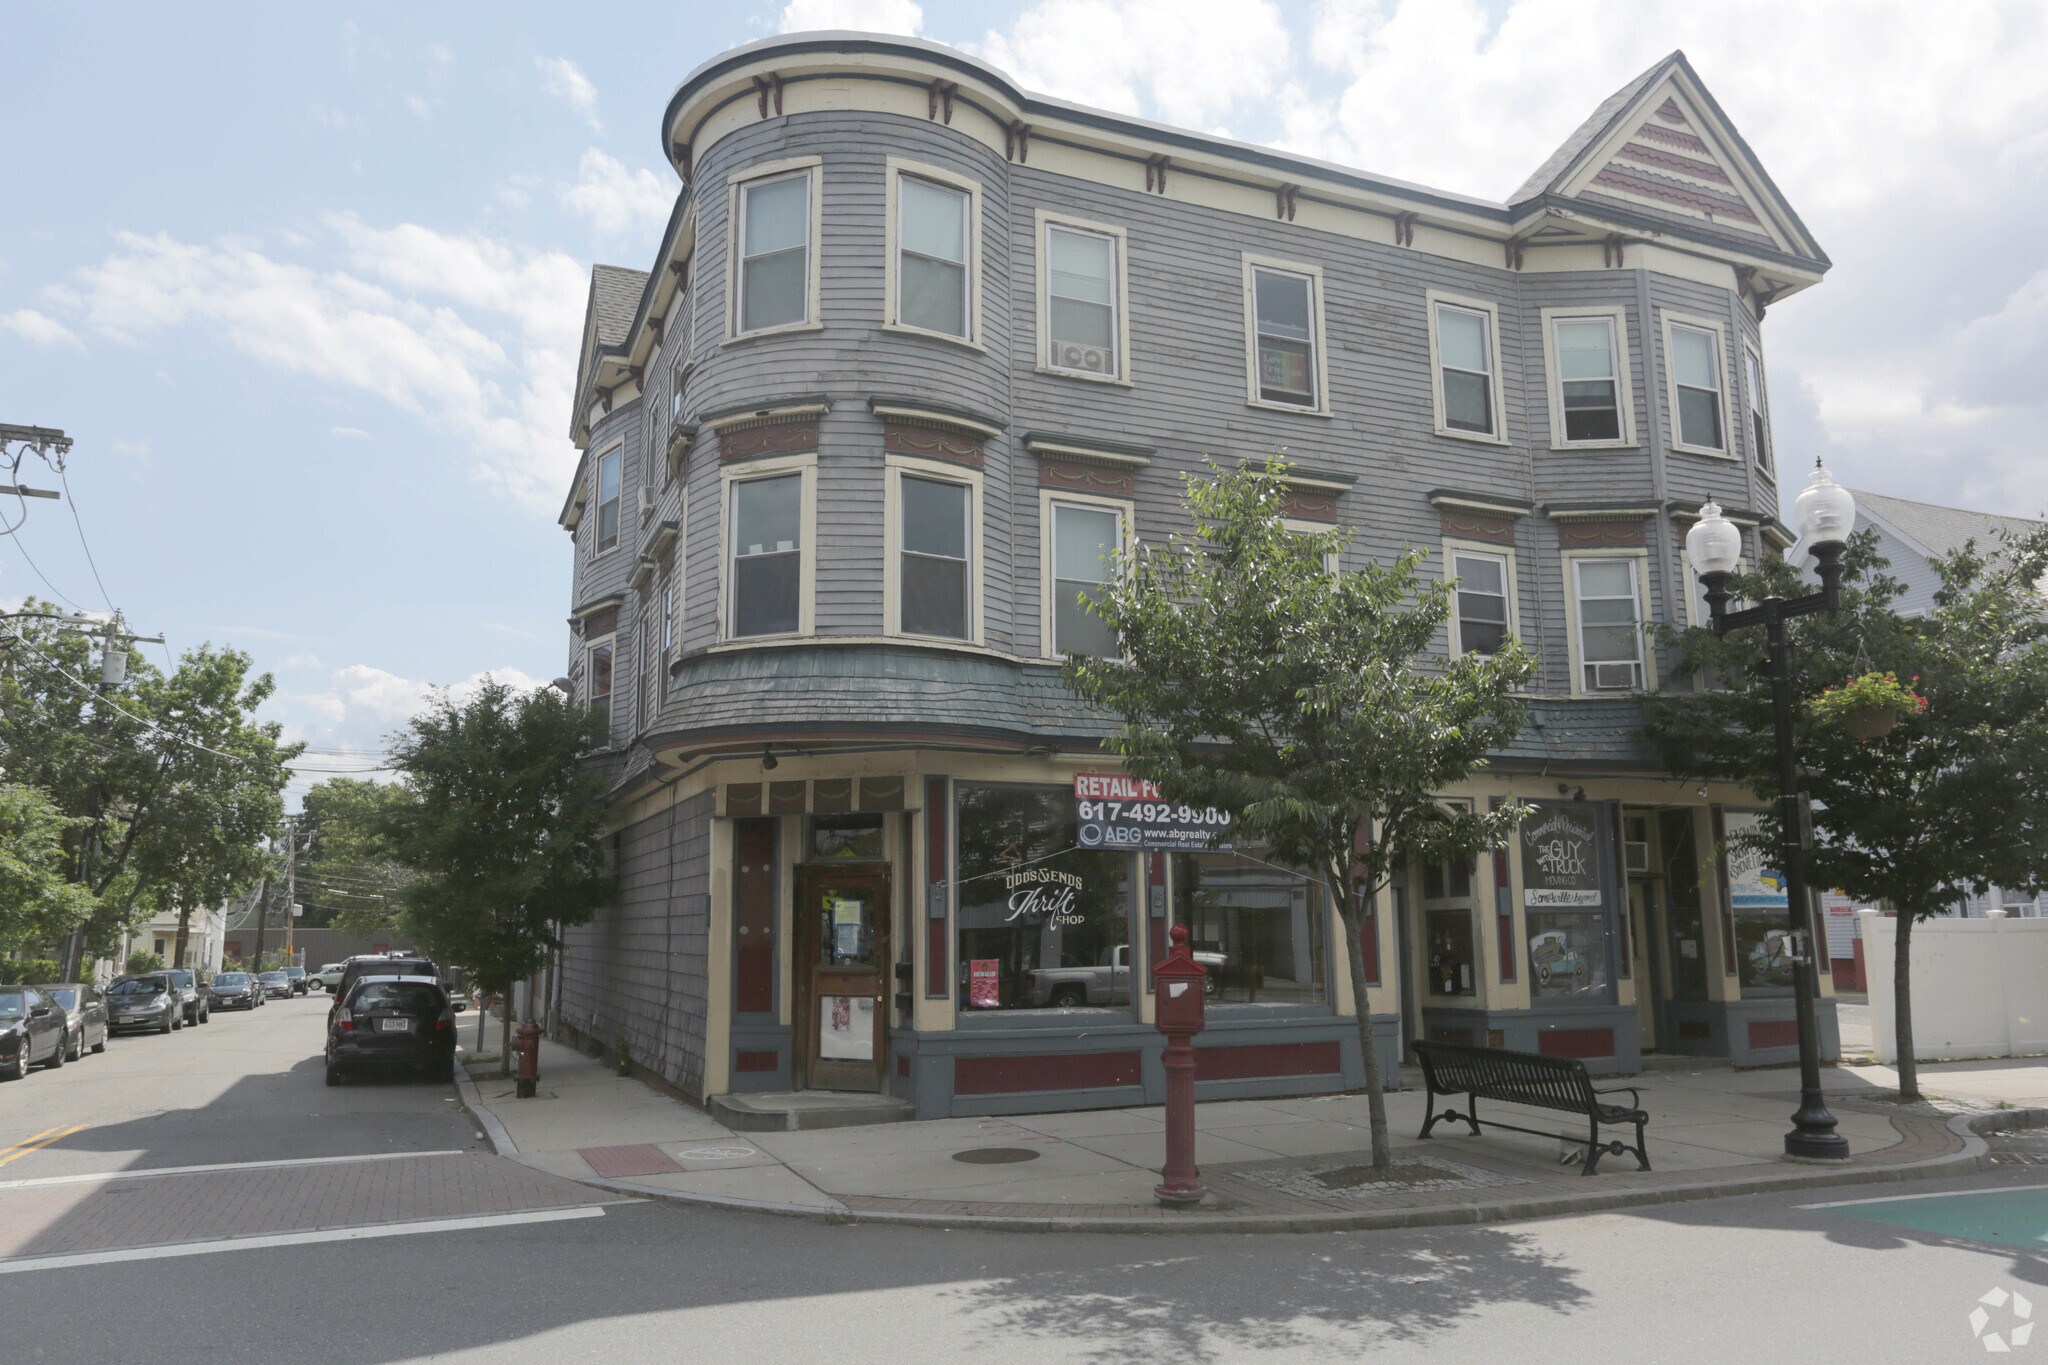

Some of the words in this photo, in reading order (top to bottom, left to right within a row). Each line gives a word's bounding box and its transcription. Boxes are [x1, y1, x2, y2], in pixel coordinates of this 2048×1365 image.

[1076, 776, 1138, 797] RETAIL
[1105, 827, 1142, 843] ABG
[1144, 840, 1177, 848] Commercial
[1537, 844, 1550, 854] THE
[1550, 839, 1582, 860] GUY
[1542, 864, 1549, 872] A
[1549, 858, 1586, 875] TRUCK
[1004, 887, 1076, 931] Thrift
[1056, 915, 1085, 925] SHOP
